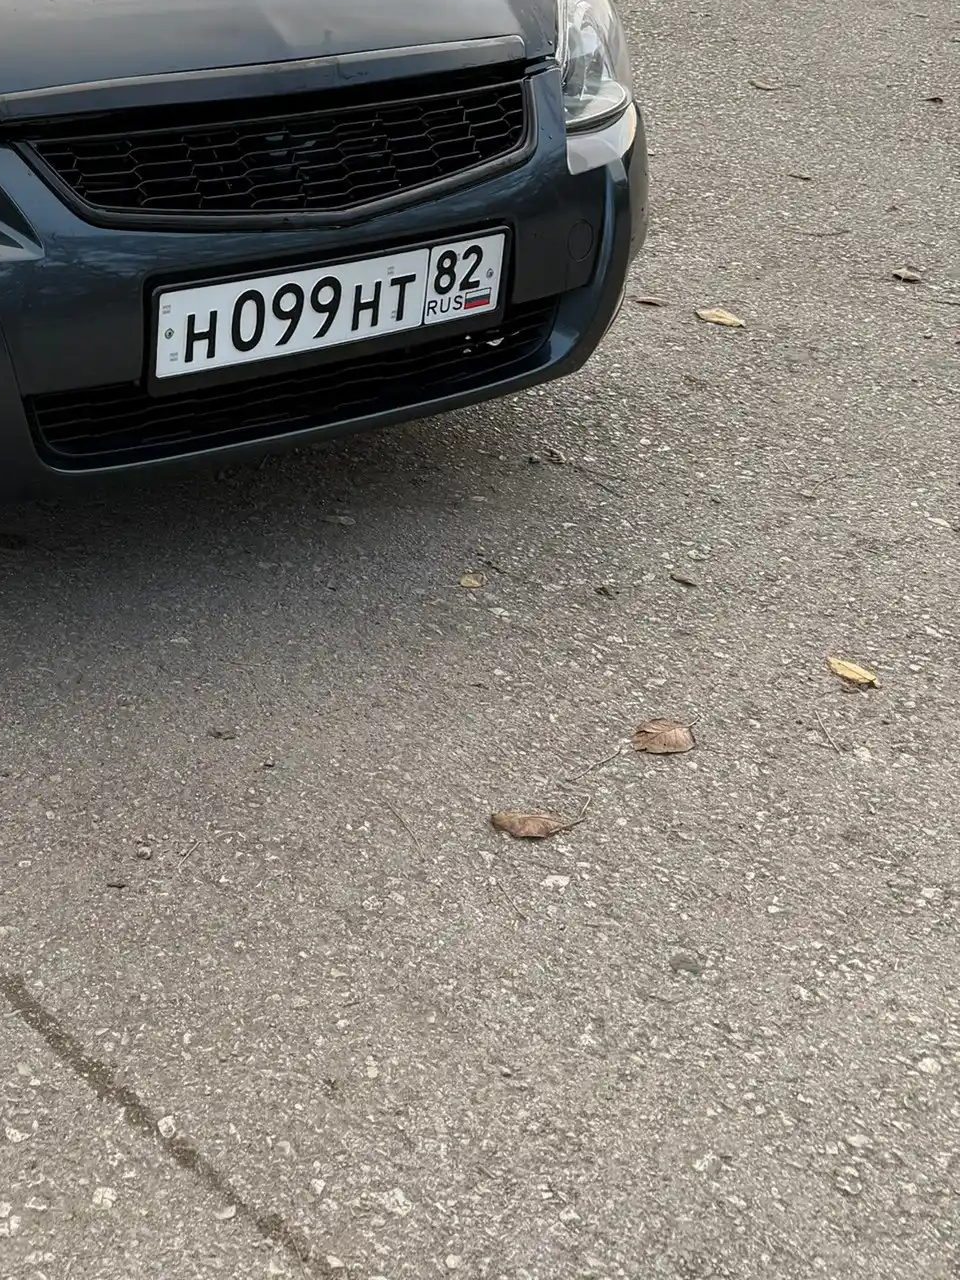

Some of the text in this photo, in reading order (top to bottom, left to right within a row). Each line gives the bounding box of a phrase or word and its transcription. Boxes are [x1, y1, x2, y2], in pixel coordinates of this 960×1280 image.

[184, 245, 484, 363] Н099НТ 82
[426, 294, 464, 317] RUS
